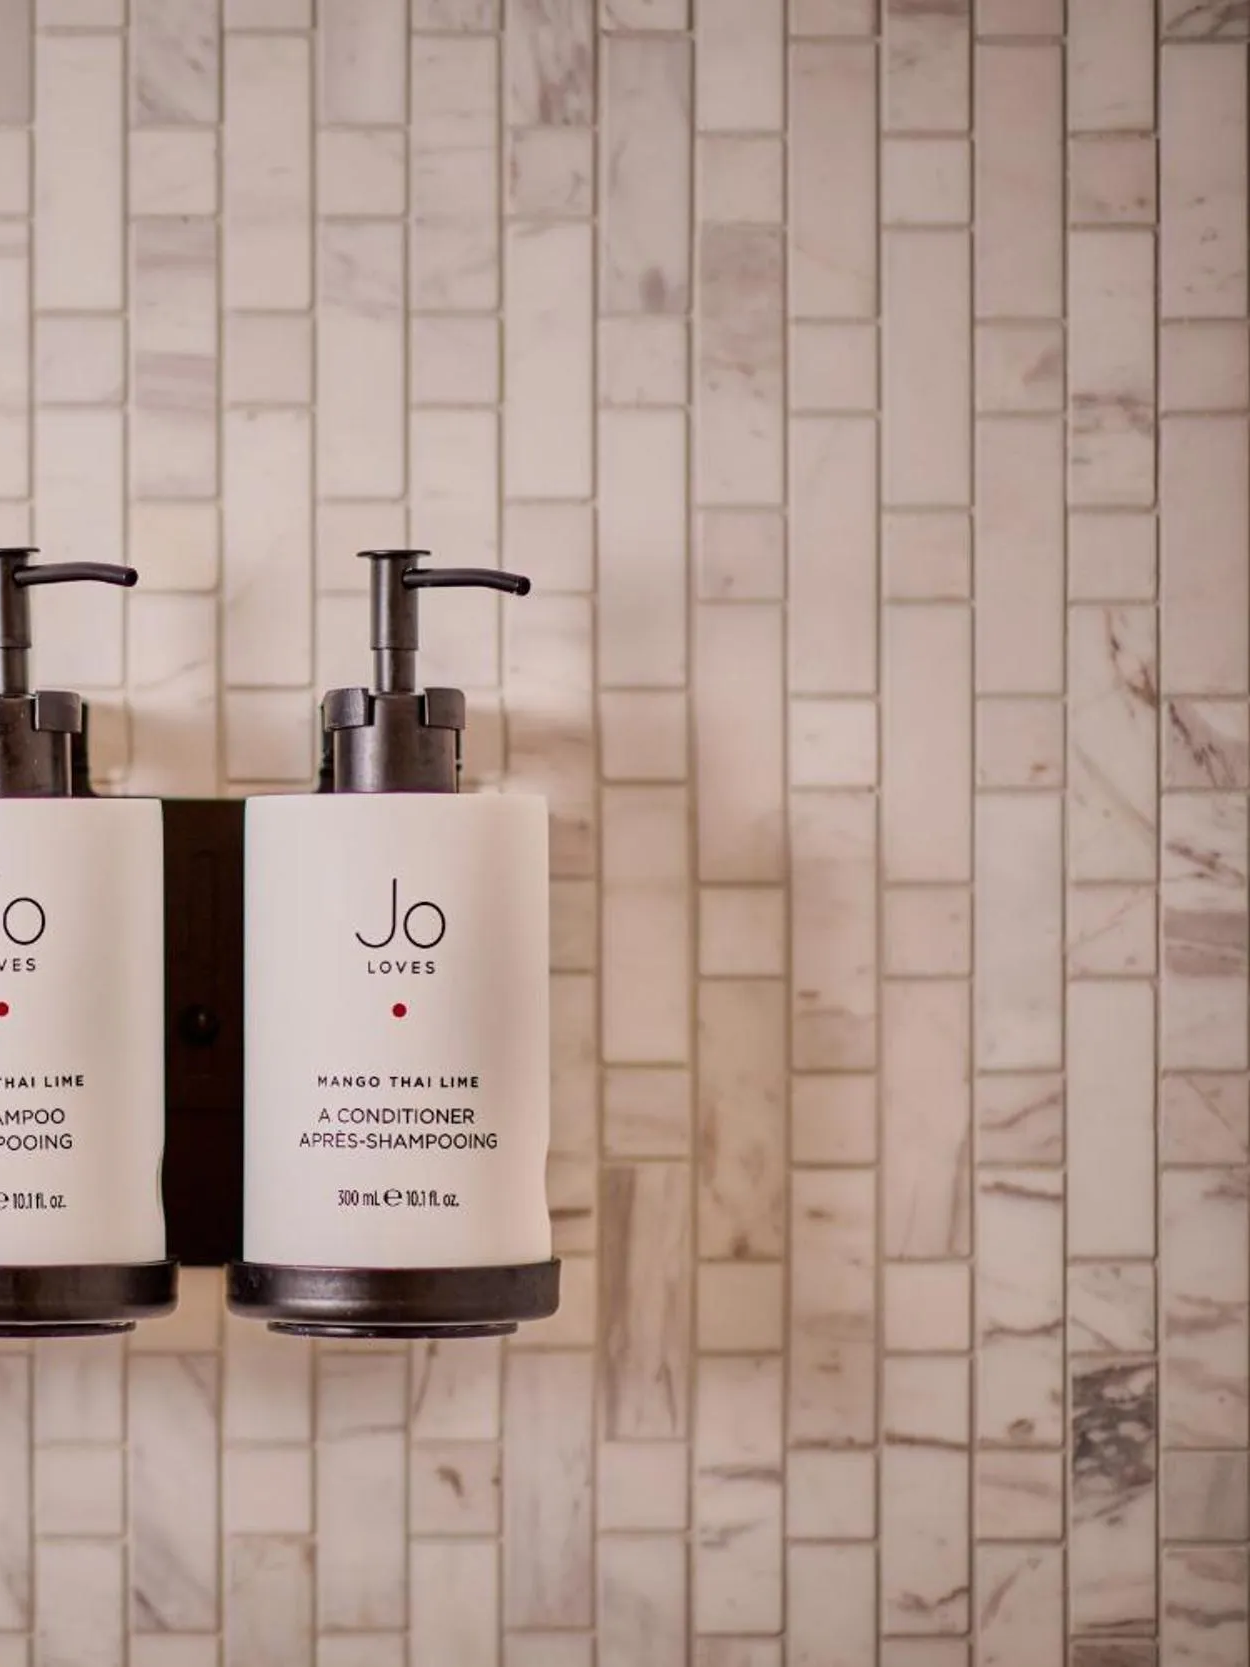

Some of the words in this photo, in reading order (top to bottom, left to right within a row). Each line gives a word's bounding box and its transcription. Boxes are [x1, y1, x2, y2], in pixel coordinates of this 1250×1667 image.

[367, 959, 436, 975] LOVES
[43, 1074, 85, 1088] LIME
[317, 1075, 381, 1089] MANGO
[389, 1075, 432, 1089] THAI
[439, 1075, 480, 1089] LIME
[317, 1108, 332, 1124] A
[336, 1107, 475, 1125] CONDITIONER
[299, 1129, 498, 1150] APRÈS-SHAMPOOING
[12, 1192, 33, 1210] 10.1
[35, 1192, 48, 1210] fl.
[49, 1194, 67, 1209] oz.
[337, 1189, 360, 1207] 300
[361, 1189, 381, 1207] mL
[405, 1189, 427, 1207] 10.1
[428, 1189, 441, 1207] fl.
[442, 1192, 460, 1208] oz.
